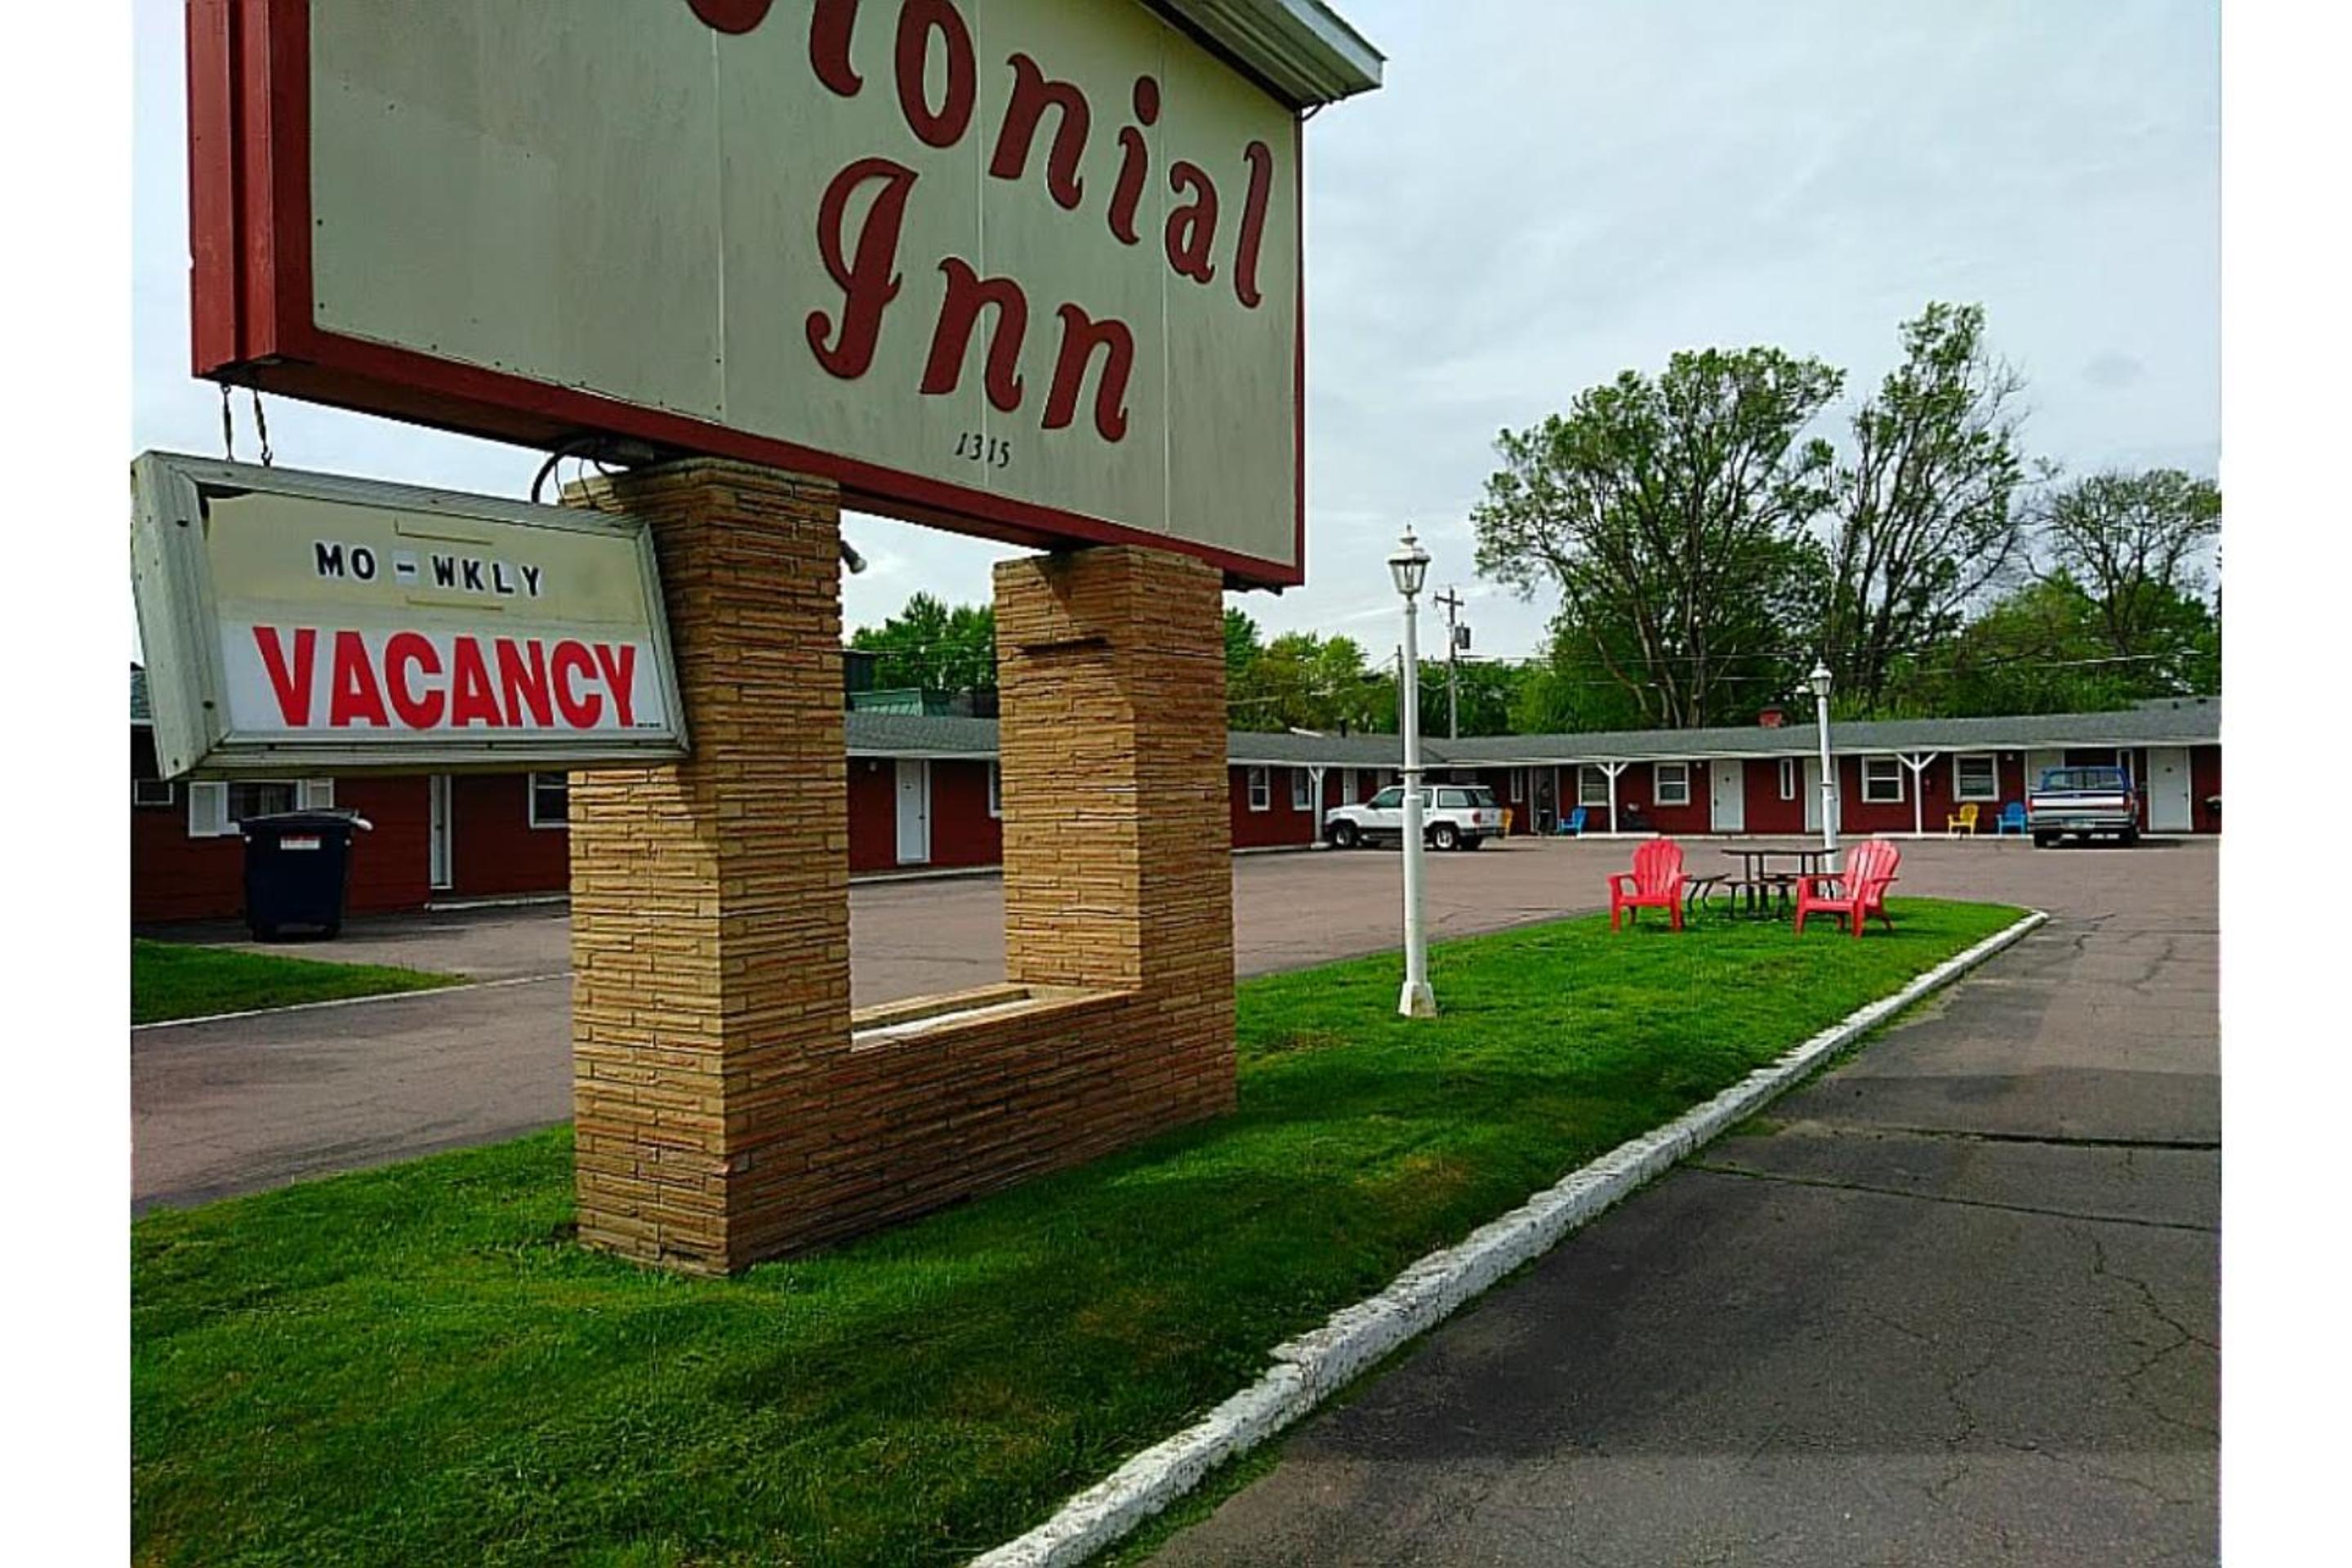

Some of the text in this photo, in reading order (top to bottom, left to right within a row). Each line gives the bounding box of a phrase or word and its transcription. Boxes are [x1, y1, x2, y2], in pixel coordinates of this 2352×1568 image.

[805, 157, 1135, 443] Inn
[954, 432, 1010, 470] 1315
[314, 541, 376, 581] MO
[431, 554, 540, 597] WKLY
[252, 626, 635, 729] VACANCY
